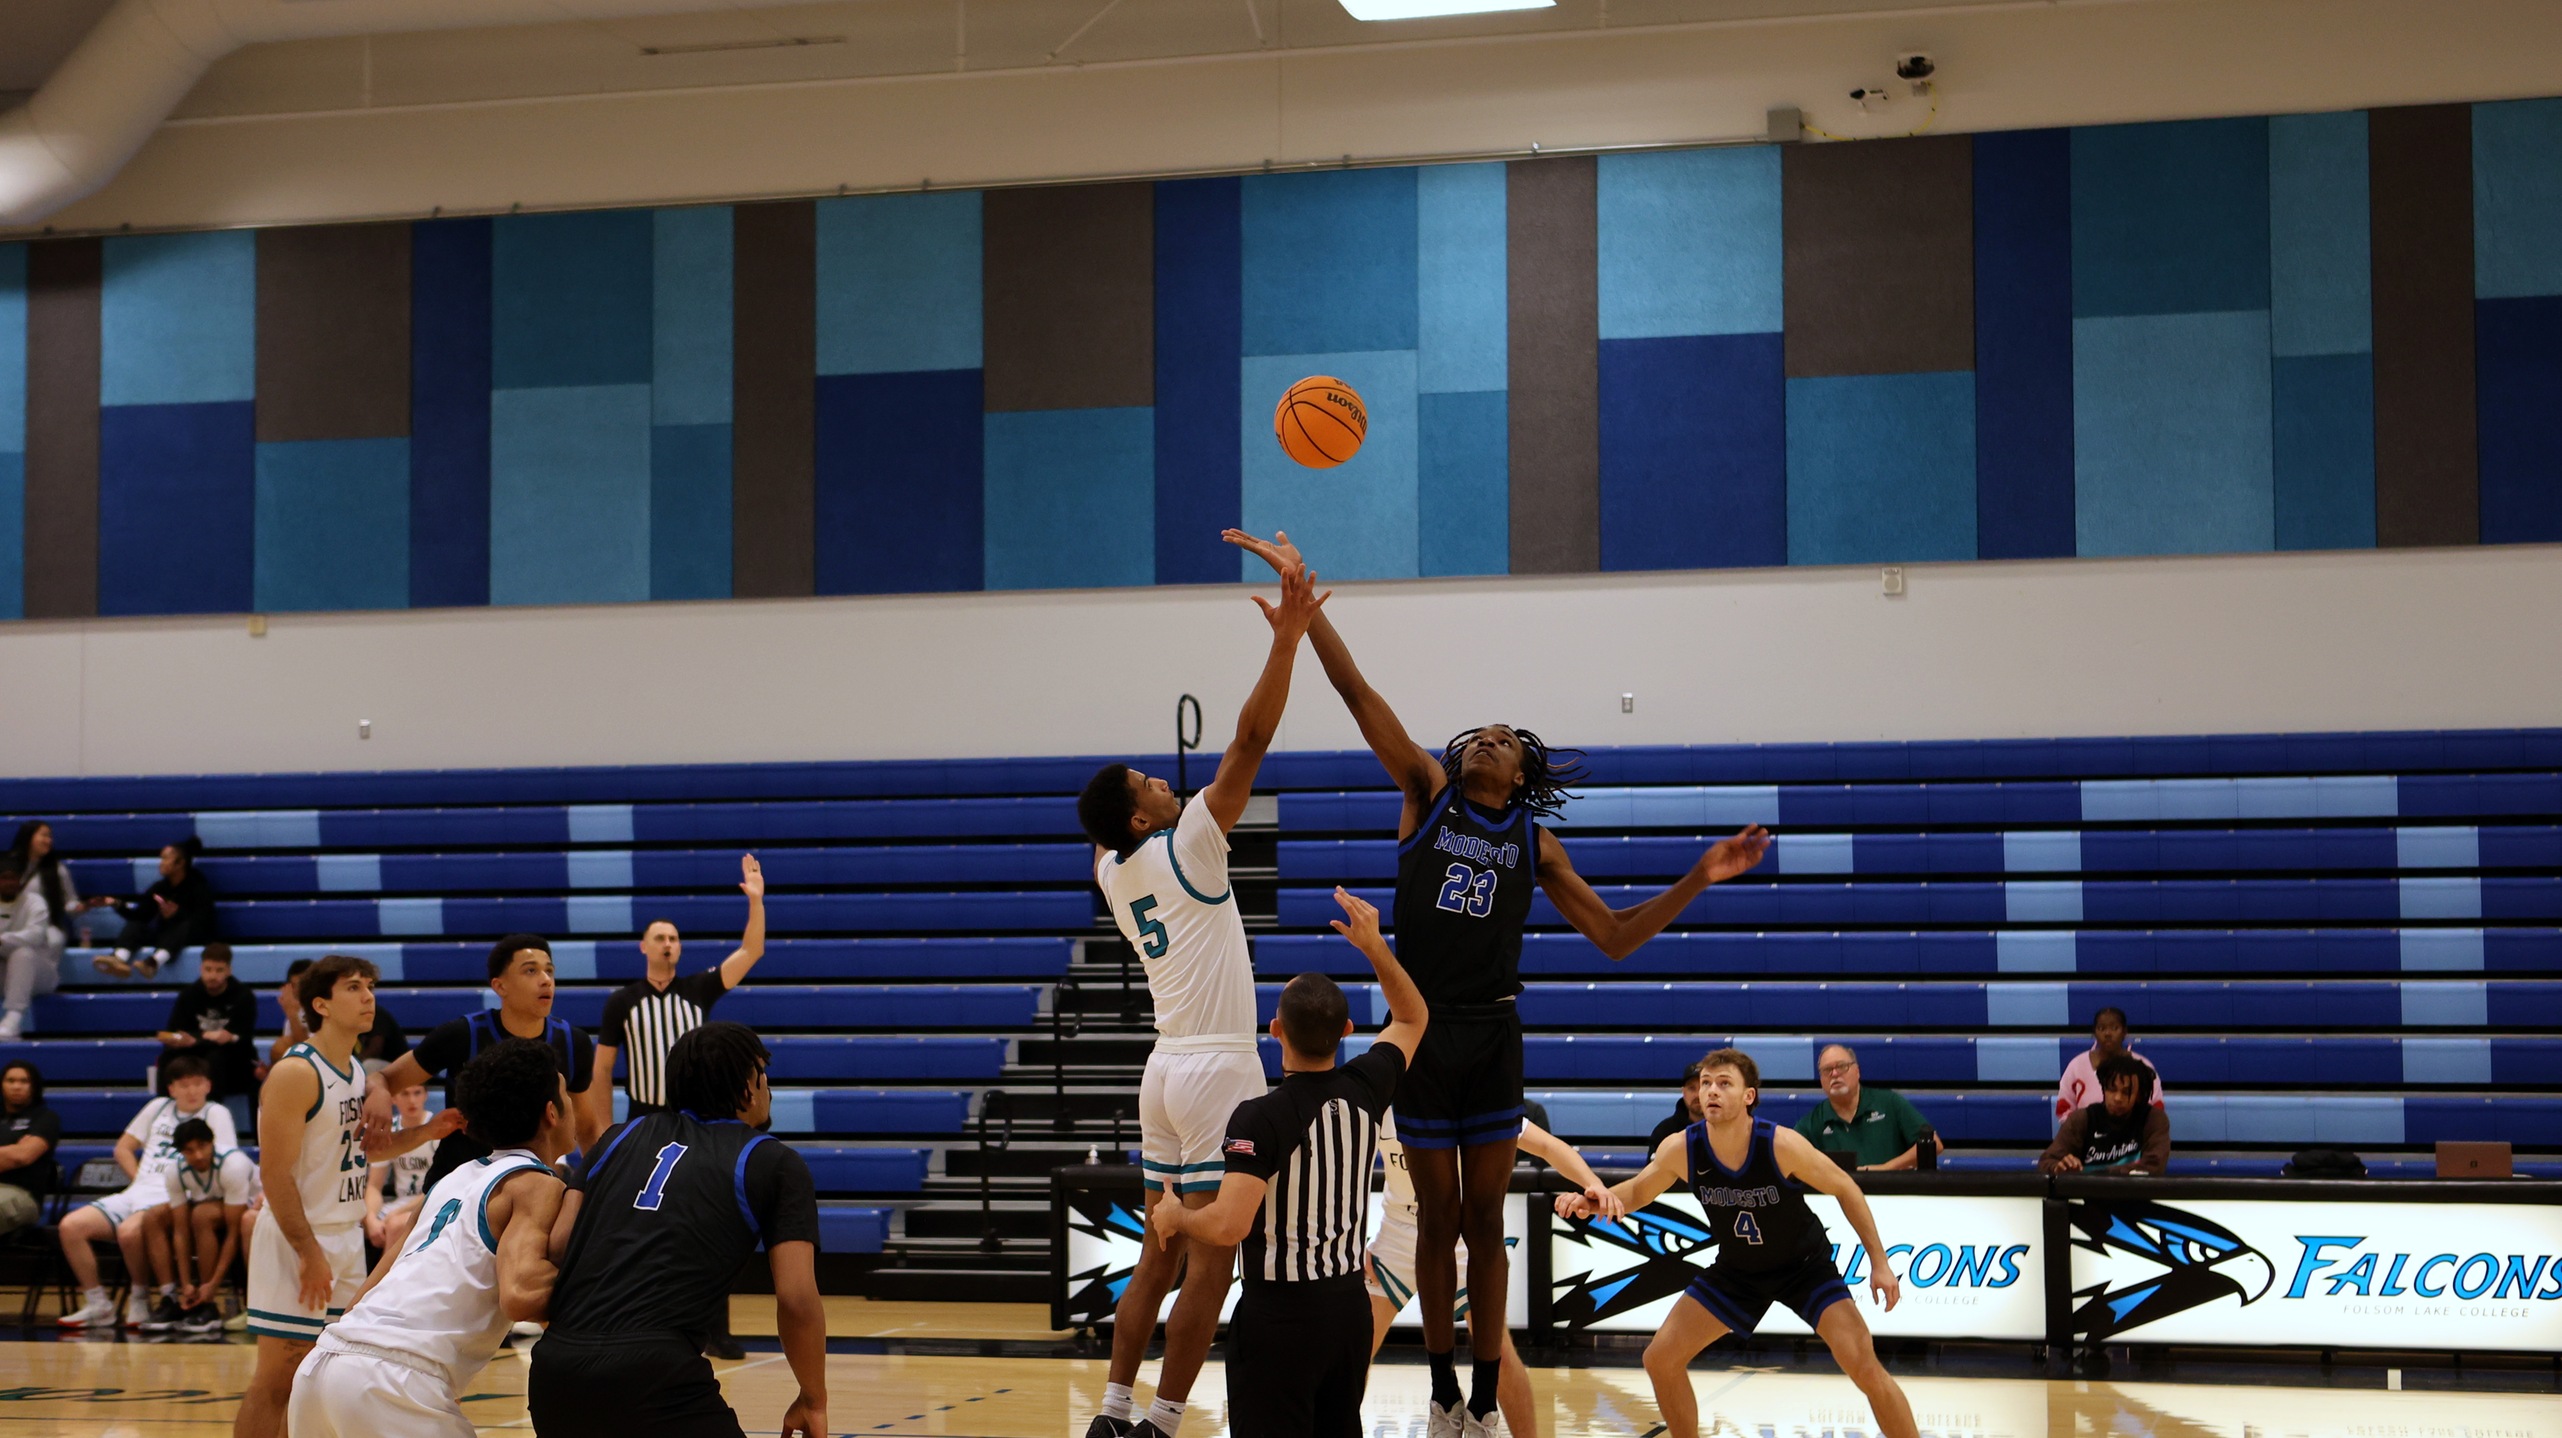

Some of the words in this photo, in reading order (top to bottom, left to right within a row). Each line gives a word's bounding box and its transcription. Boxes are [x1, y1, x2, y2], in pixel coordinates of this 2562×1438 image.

[1326, 392, 1368, 436] Wilson
[1436, 862, 1498, 918] 23
[1129, 893, 1170, 959] 5
[633, 1141, 689, 1211] 1
[1699, 1185, 1780, 1208] MODESTO
[1733, 1210, 1764, 1245] 4
[1914, 1295, 1980, 1306] COLLEGE
[2343, 1304, 2404, 1315] FOLSOM
[2414, 1305, 2450, 1317] LAKE
[2459, 1306, 2530, 1319] COLLEGE
